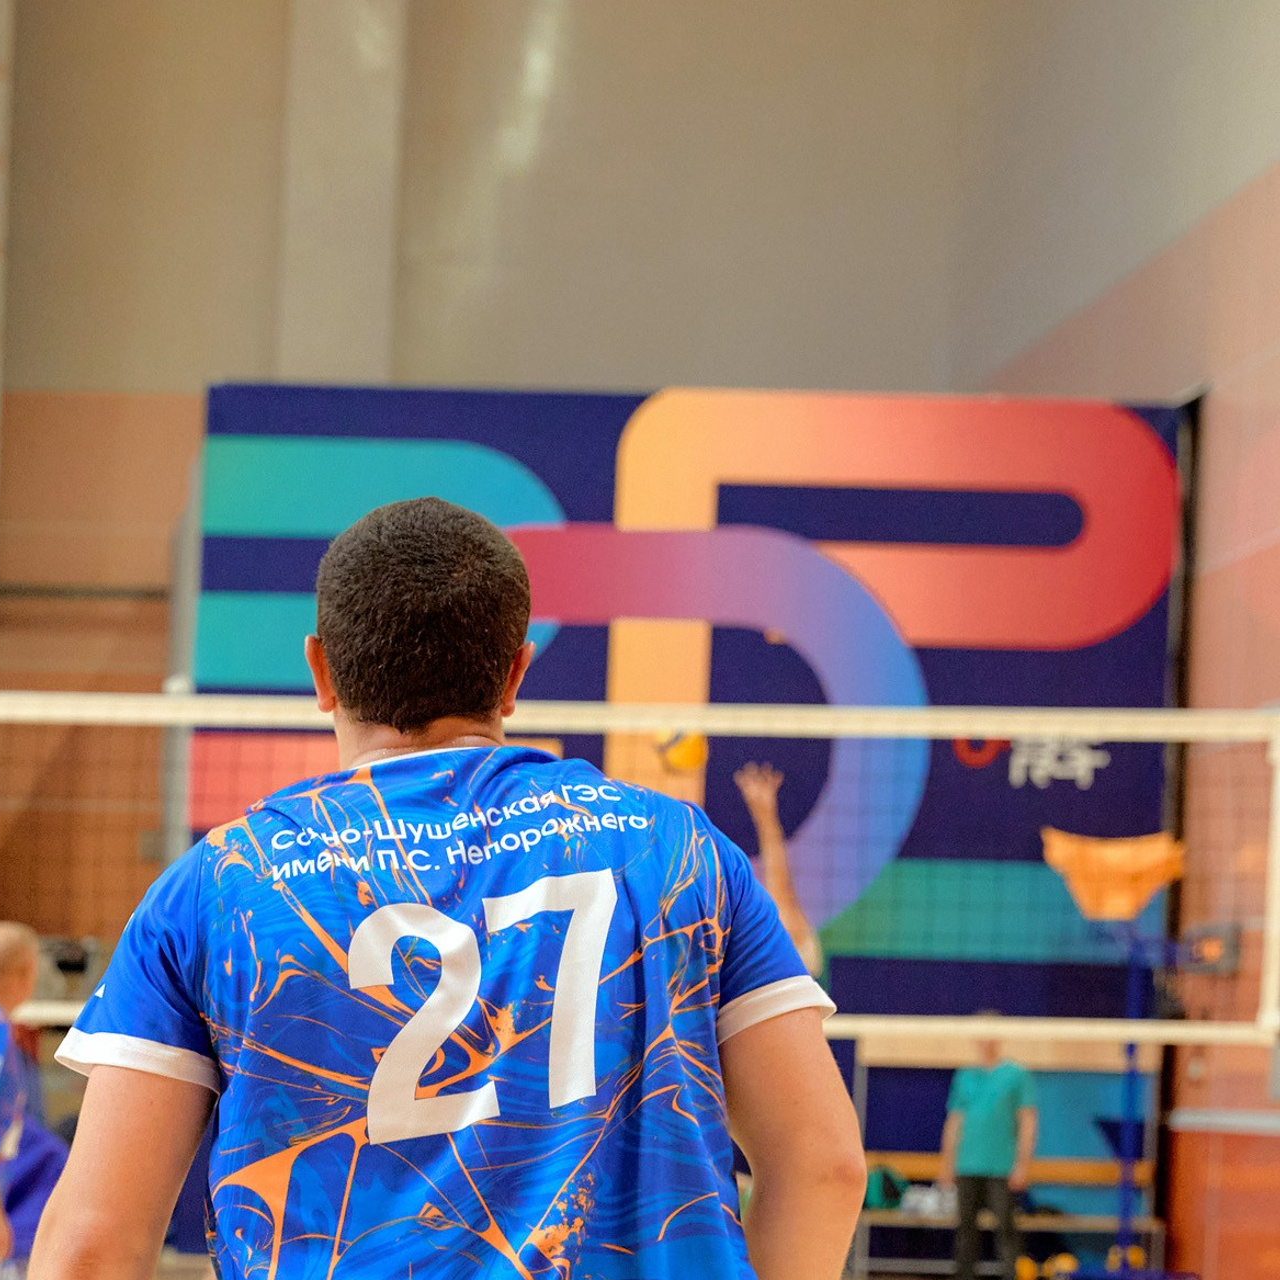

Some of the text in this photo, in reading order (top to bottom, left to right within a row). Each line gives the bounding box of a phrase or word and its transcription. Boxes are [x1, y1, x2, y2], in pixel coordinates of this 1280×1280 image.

[561, 784, 622, 804] ГЭС
[272, 812, 648, 881] имени П.С. Непорожнего
[347, 868, 618, 1145] 27
